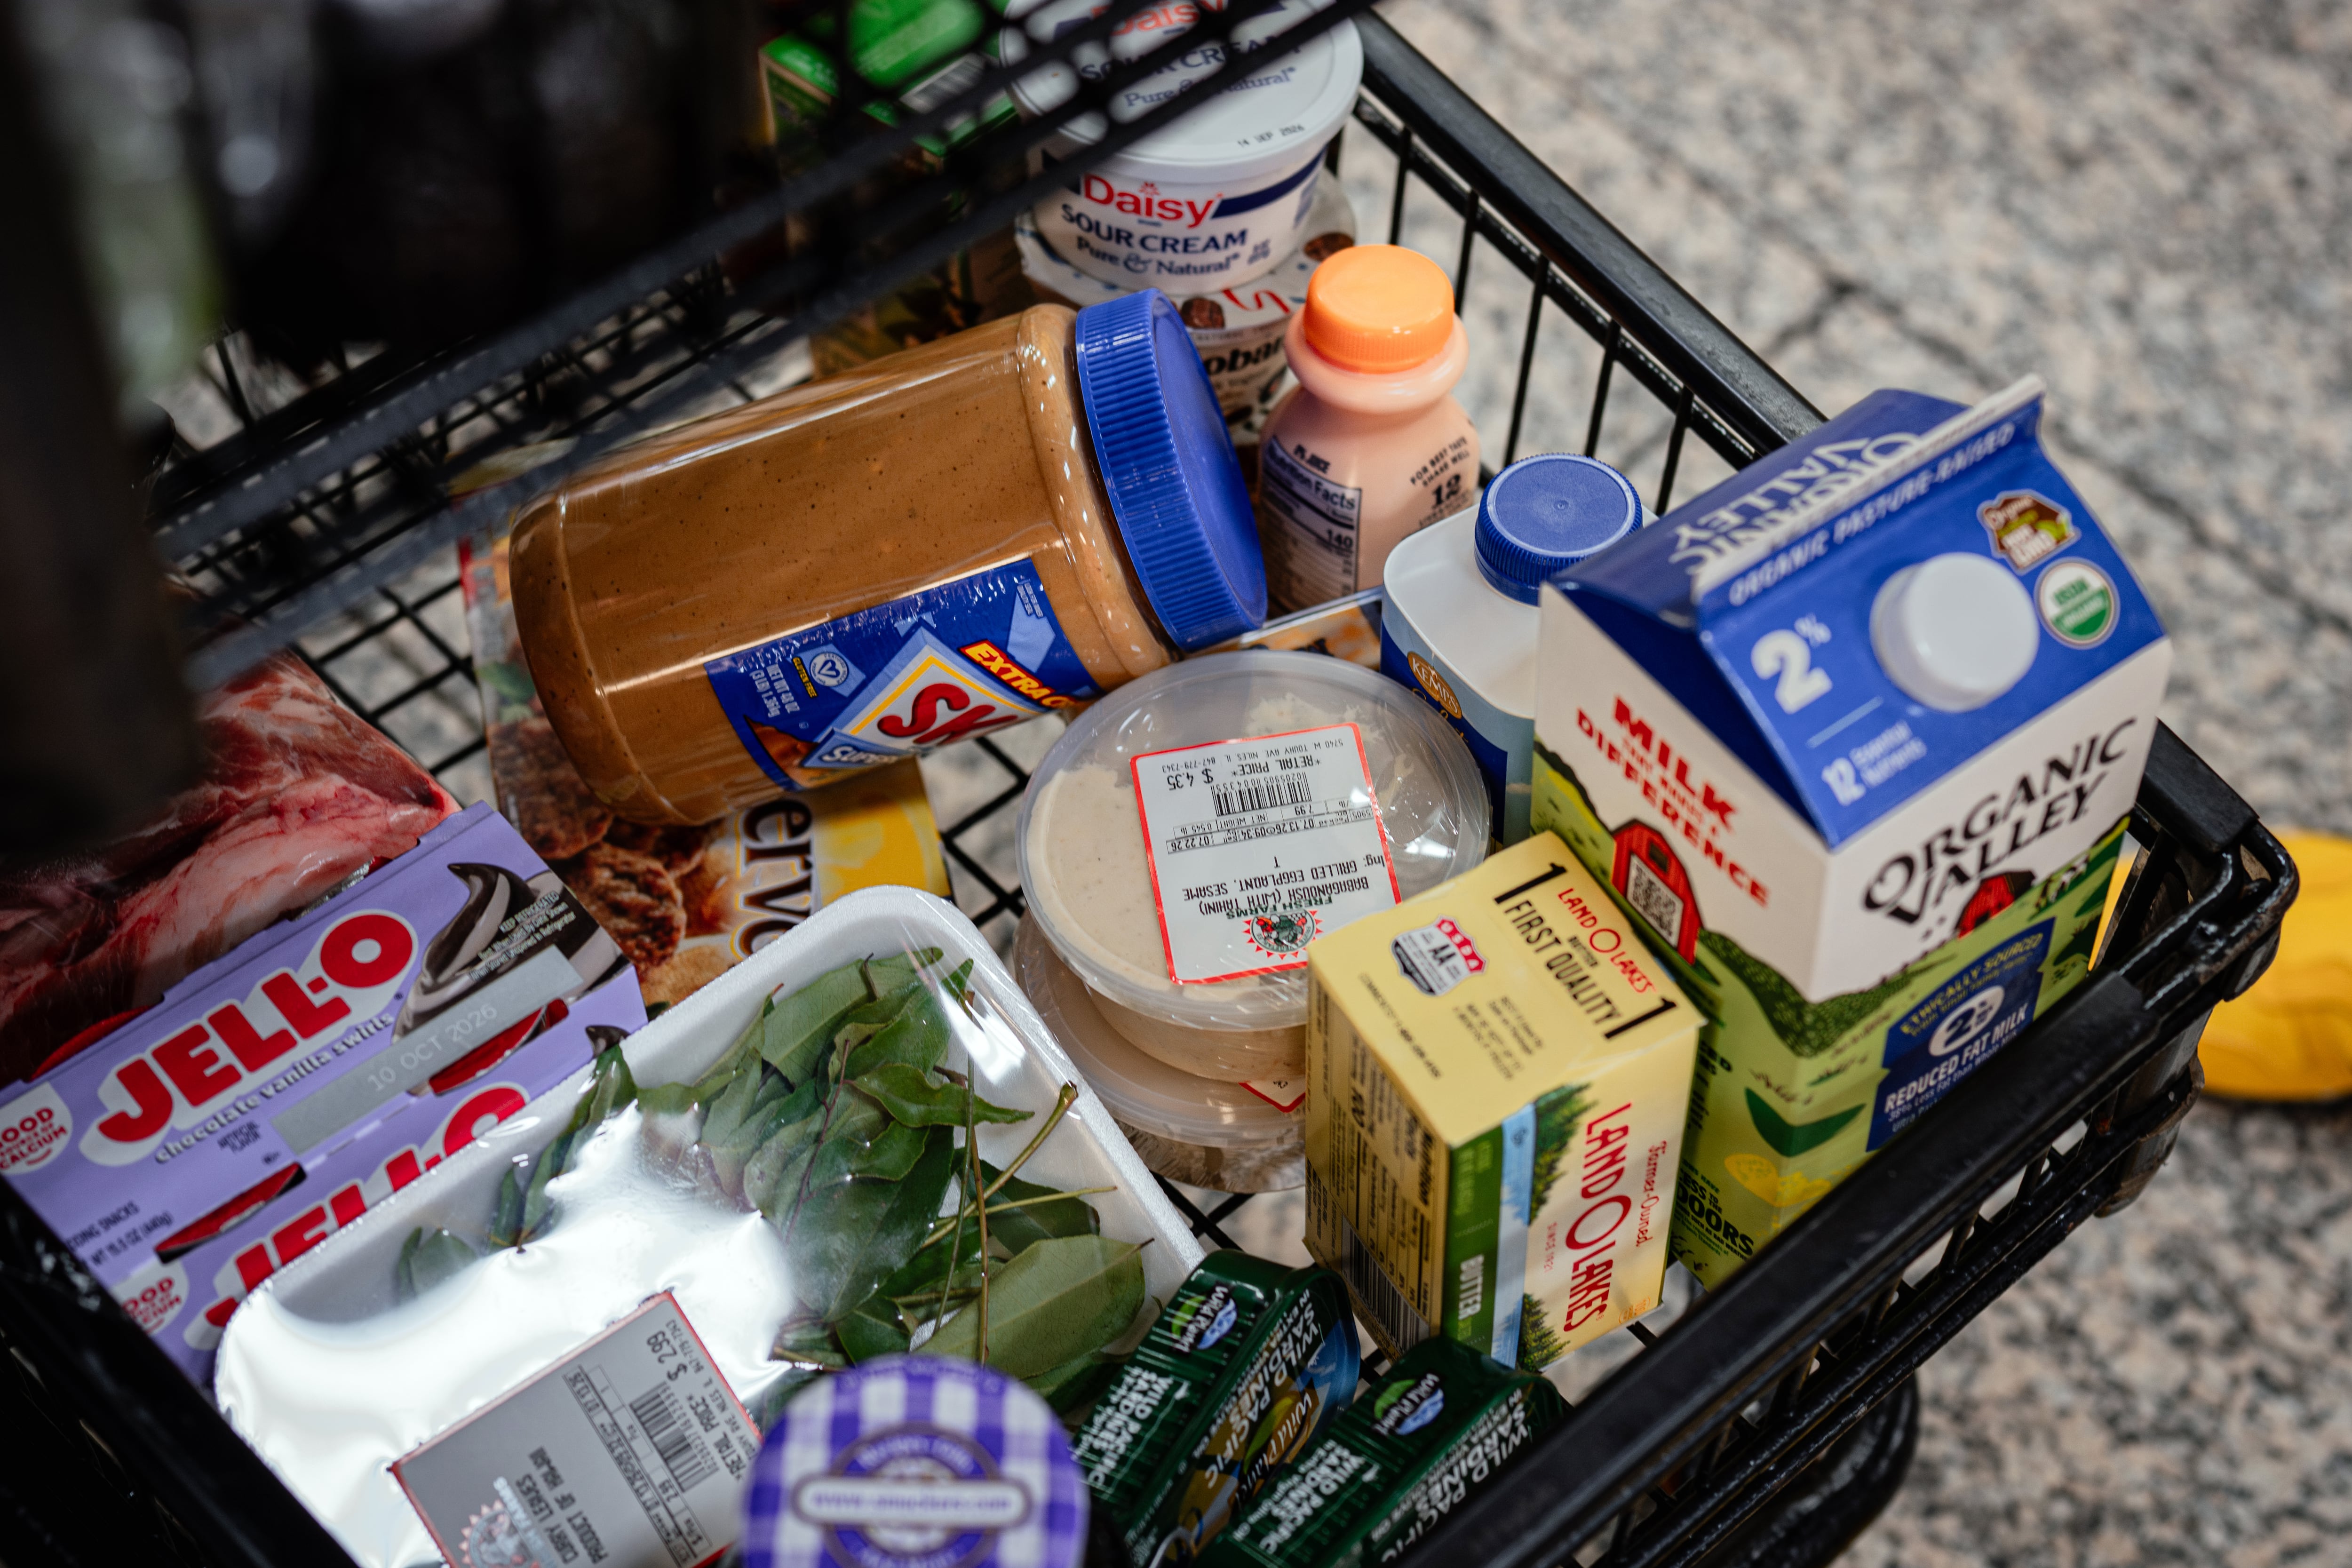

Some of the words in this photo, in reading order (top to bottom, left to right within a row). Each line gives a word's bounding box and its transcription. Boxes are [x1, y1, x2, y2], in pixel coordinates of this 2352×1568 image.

[1084, 174, 1214, 229] Daisy
[1061, 203, 1134, 248] SOUR
[1140, 228, 1248, 255] CREAM
[1077, 236, 1120, 267] Pure
[1123, 252, 1153, 274] &
[1410, 466, 1428, 486] FOR
[1430, 448, 1448, 468] BEST
[1422, 464, 1450, 488] SHAKE
[1314, 479, 1355, 510] Facts
[1431, 473, 1461, 508] 12
[1673, 437, 1872, 551] VALLEY
[1729, 529, 1830, 606] ORGANIC
[1833, 422, 2016, 544] PASTURE-RAISED
[1326, 529, 1353, 549] 140
[766, 663, 784, 680] NET
[964, 643, 1053, 700] EXTRA
[1412, 657, 1458, 714] KEMPS
[1224, 754, 1232, 763] IL
[1284, 743, 1309, 755] TOUHY
[1325, 738, 1343, 749] 5740
[1162, 756, 1216, 773] 847-779-7343
[1167, 773, 1194, 791] 4.35
[1201, 768, 1214, 784] $
[1263, 773, 1302, 785] 0205905
[1614, 696, 1737, 832] MILK
[1216, 780, 1256, 792] 004355
[1191, 822, 1212, 833] 0.545
[1219, 816, 1246, 830] WEIGHT
[1251, 814, 1266, 823] NET
[1274, 817, 1315, 834] 07.13.26
[1294, 805, 1312, 816] 7.99
[1351, 810, 1372, 820] 5905
[1577, 708, 1769, 908] DIFFERENCE
[1861, 717, 2136, 914] ORGANIC
[1170, 836, 1210, 851] 07.22.26
[1241, 826, 1267, 839] 09:34
[1884, 772, 2106, 927] VALLEY
[1274, 856, 1280, 868] T
[1311, 860, 1358, 880] GRILLED
[1363, 854, 1385, 868] Ing:
[1182, 882, 1228, 901] SESAME
[1199, 898, 1243, 915] TAHINI)
[1247, 888, 1282, 908] (WITH
[1278, 895, 1333, 912] FRESH
[1288, 876, 1369, 901] BABAGANOUSH
[499, 917, 516, 934] KEEP
[514, 890, 560, 923] REFRIGERATED
[1226, 905, 1276, 919] FARMS
[1427, 943, 1456, 967] AA
[1440, 920, 1481, 970] USDA
[1557, 887, 1598, 929] LAND
[1589, 928, 1621, 954] O
[1610, 951, 1654, 995] LAKES
[1504, 899, 1563, 955] FIRST
[1545, 952, 1623, 1026] QUALITY
[1900, 967, 1982, 1035] ETHICALLY
[97, 914, 414, 1144] JELL-O
[367, 1064, 397, 1092] 10
[399, 1035, 445, 1072] OCT
[446, 1002, 499, 1043] 2026
[1943, 1006, 1976, 1049] 2
[1884, 1054, 1960, 1114] REDUCED
[1961, 1031, 1991, 1066] FAT
[1991, 1002, 2029, 1045] MILK
[155, 1093, 262, 1165] chocolate
[259, 1049, 333, 1100] vanilla
[332, 1011, 396, 1056] swirls
[1580, 1101, 1632, 1200] LAND
[1708, 1192, 1719, 1205] TO
[1565, 1194, 1632, 1251] O
[1299, 1288, 1311, 1307] IN
[1458, 1254, 1485, 1321] BUTTER
[1563, 1240, 1617, 1333] LAKES
[1269, 1305, 1299, 1349] EXTRA
[667, 1362, 688, 1382] $
[1229, 1302, 1315, 1433] SARDINES
[1273, 1322, 1319, 1387] WILD
[1133, 1375, 1175, 1419] WILD
[1508, 1388, 1522, 1408] IN
[1205, 1386, 1272, 1489] PACIFIC
[1277, 1392, 1313, 1449] Wild
[1088, 1418, 1143, 1486] PACIFIC
[1415, 1402, 1525, 1522] SARDINES
[1472, 1424, 1529, 1483] WILD
[1318, 1454, 1365, 1496] WILD
[516, 1473, 554, 1523] LEAVES
[553, 1492, 577, 1511] OF
[544, 1522, 579, 1565] CURRY
[566, 1510, 608, 1565] PRODUCT
[1259, 1494, 1326, 1554] PACIFIC
